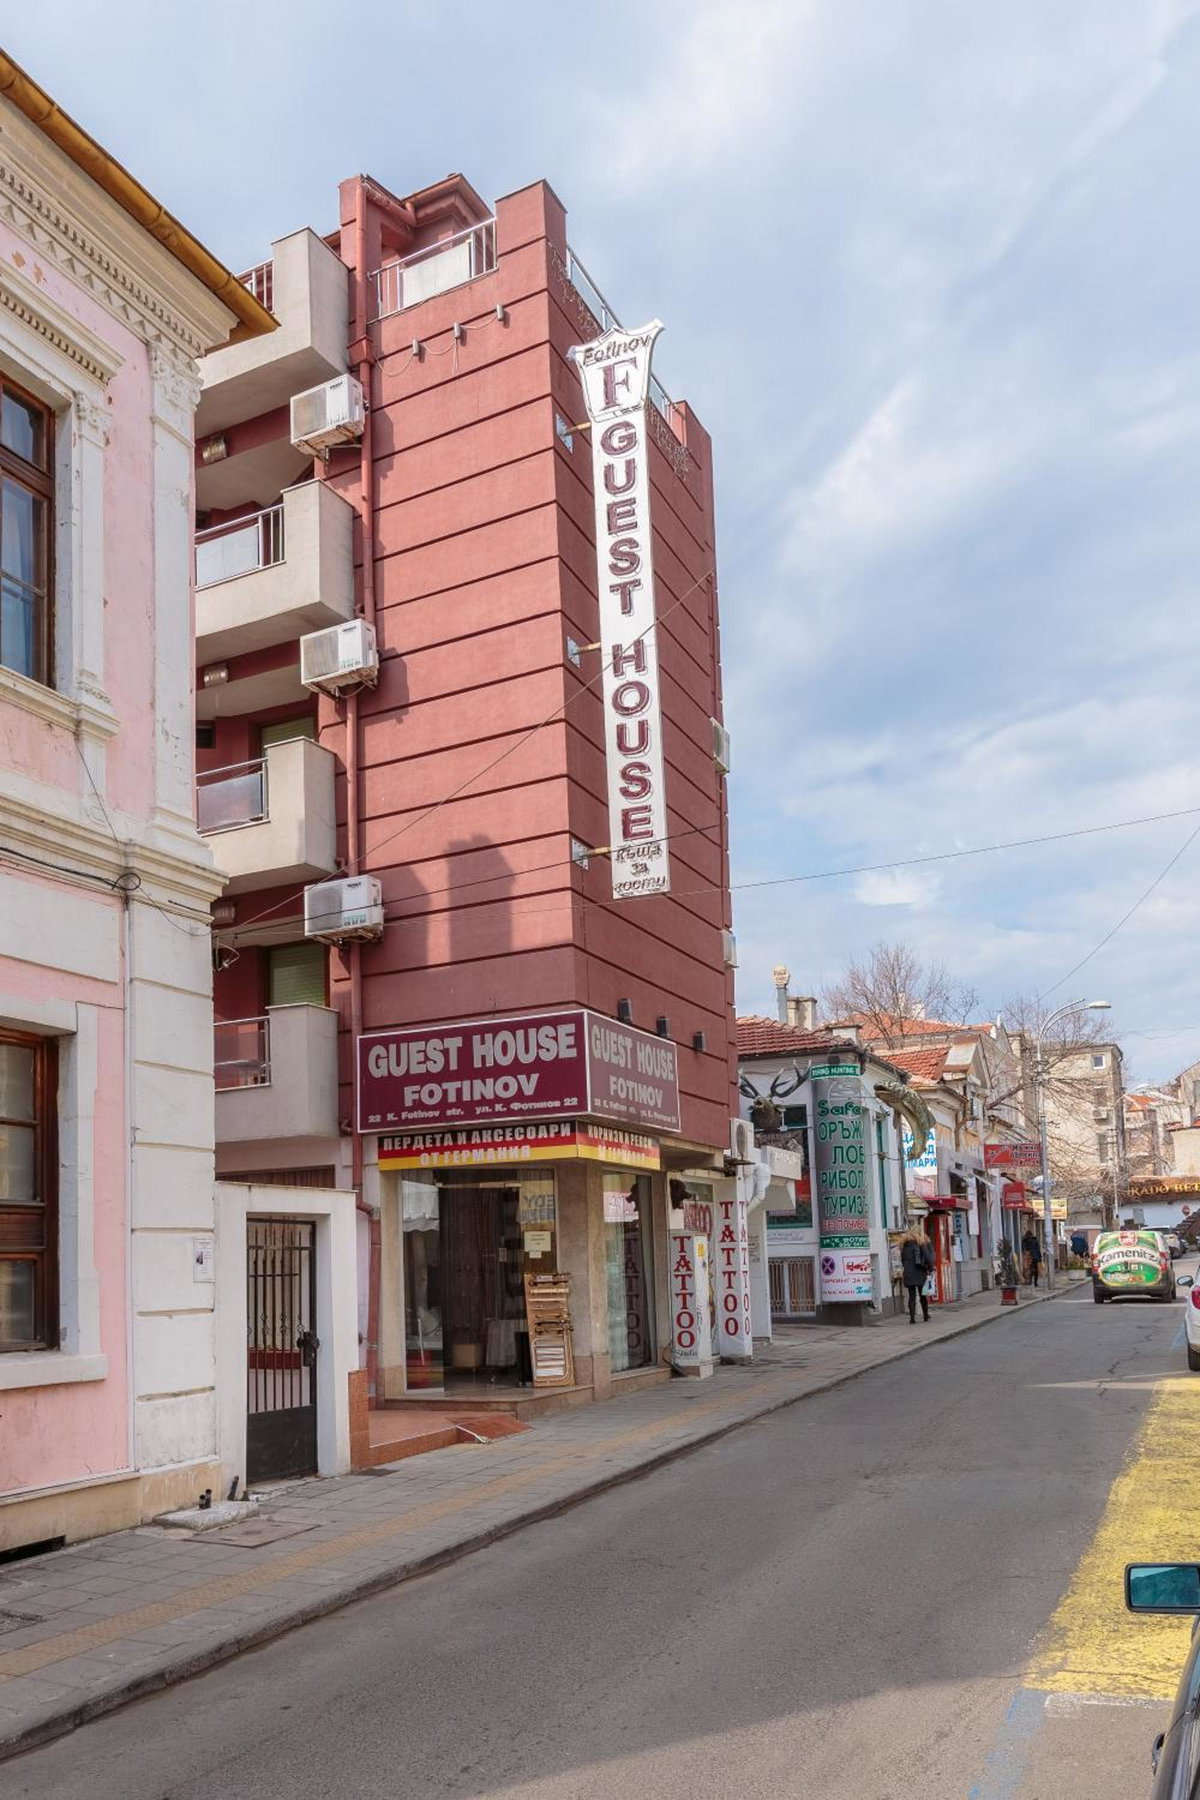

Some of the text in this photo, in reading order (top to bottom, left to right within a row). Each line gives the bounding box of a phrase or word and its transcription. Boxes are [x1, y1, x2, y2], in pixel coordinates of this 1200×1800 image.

[583, 335, 652, 365] Fotinov
[598, 357, 639, 411] F
[600, 421, 653, 840] GUEST HOUSE
[367, 1023, 577, 1079] GUEST HOUSE
[591, 1024, 674, 1081] GUEST HOUSE
[403, 1073, 540, 1107] FOTINOV
[475, 1097, 579, 1115] ул. К. Фотинов 22
[608, 1074, 663, 1108] FOTINOV
[386, 1112, 399, 1122] K.
[401, 1109, 441, 1120] Fotinov
[445, 1106, 465, 1116] str.
[383, 1122, 572, 1151] ПЕРДЕТА И АКСЕСОАРИ
[420, 1145, 532, 1166] ОТ ГЕРМАНИЯ
[823, 1194, 866, 1216] ТУРИЗ
[719, 1200, 739, 1336] TATTOO
[738, 1200, 750, 1336] TATTOO
[673, 1236, 696, 1349] TATTOO
